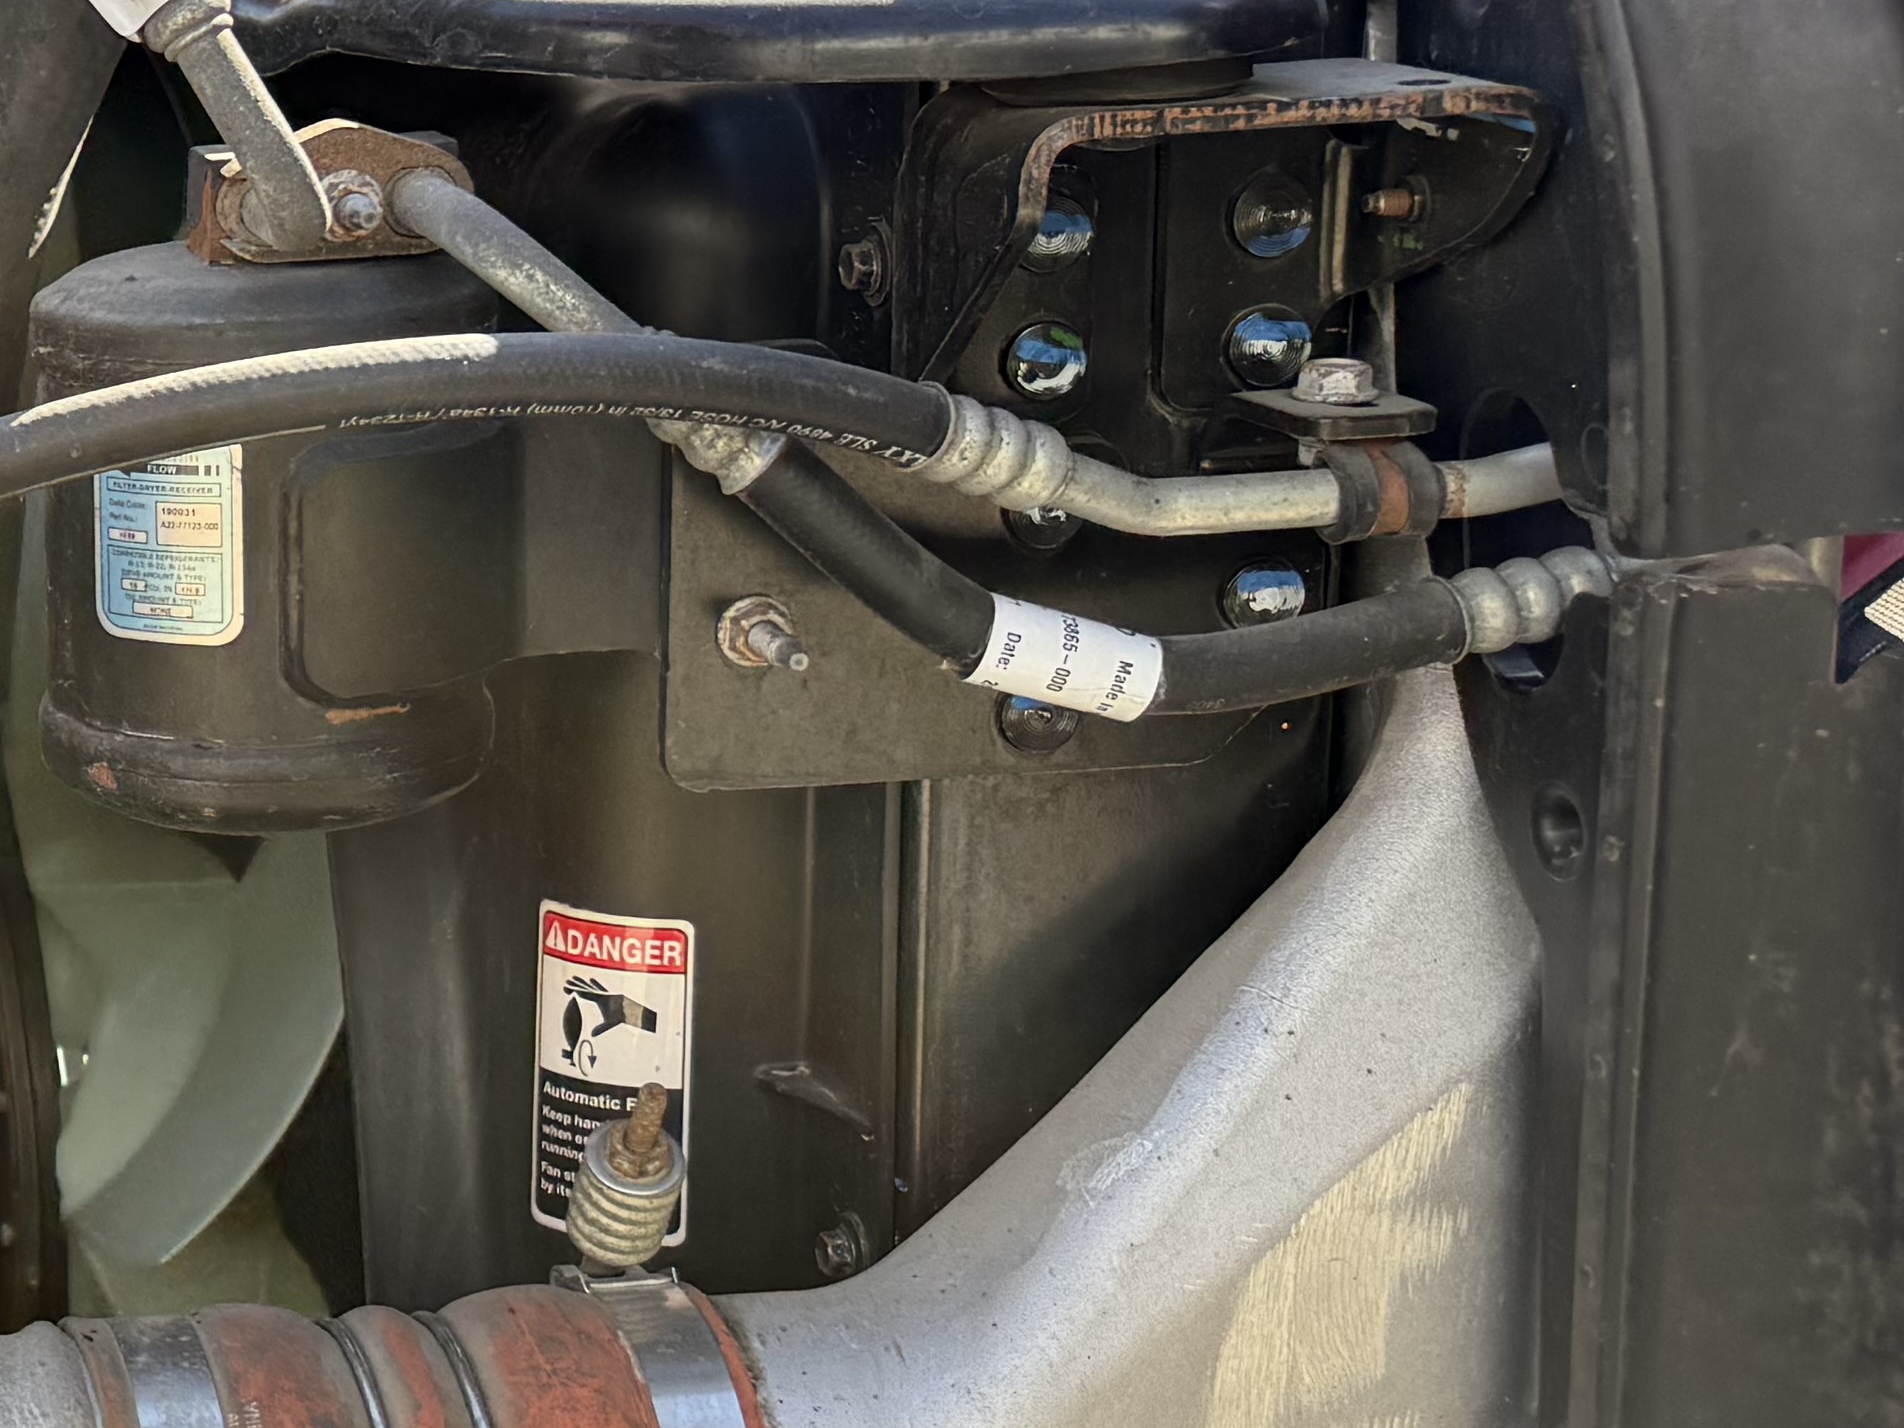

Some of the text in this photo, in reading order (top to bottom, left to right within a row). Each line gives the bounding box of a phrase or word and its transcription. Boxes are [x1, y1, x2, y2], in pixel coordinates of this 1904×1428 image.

[147, 465, 177, 475] FLOW
[995, 631, 1021, 670] Date:
[1105, 660, 1134, 701] Made
[567, 928, 685, 967] DANGER
[542, 1081, 623, 1111] Automatic
[542, 1105, 572, 1126] Keep
[541, 1161, 564, 1179] Fan
